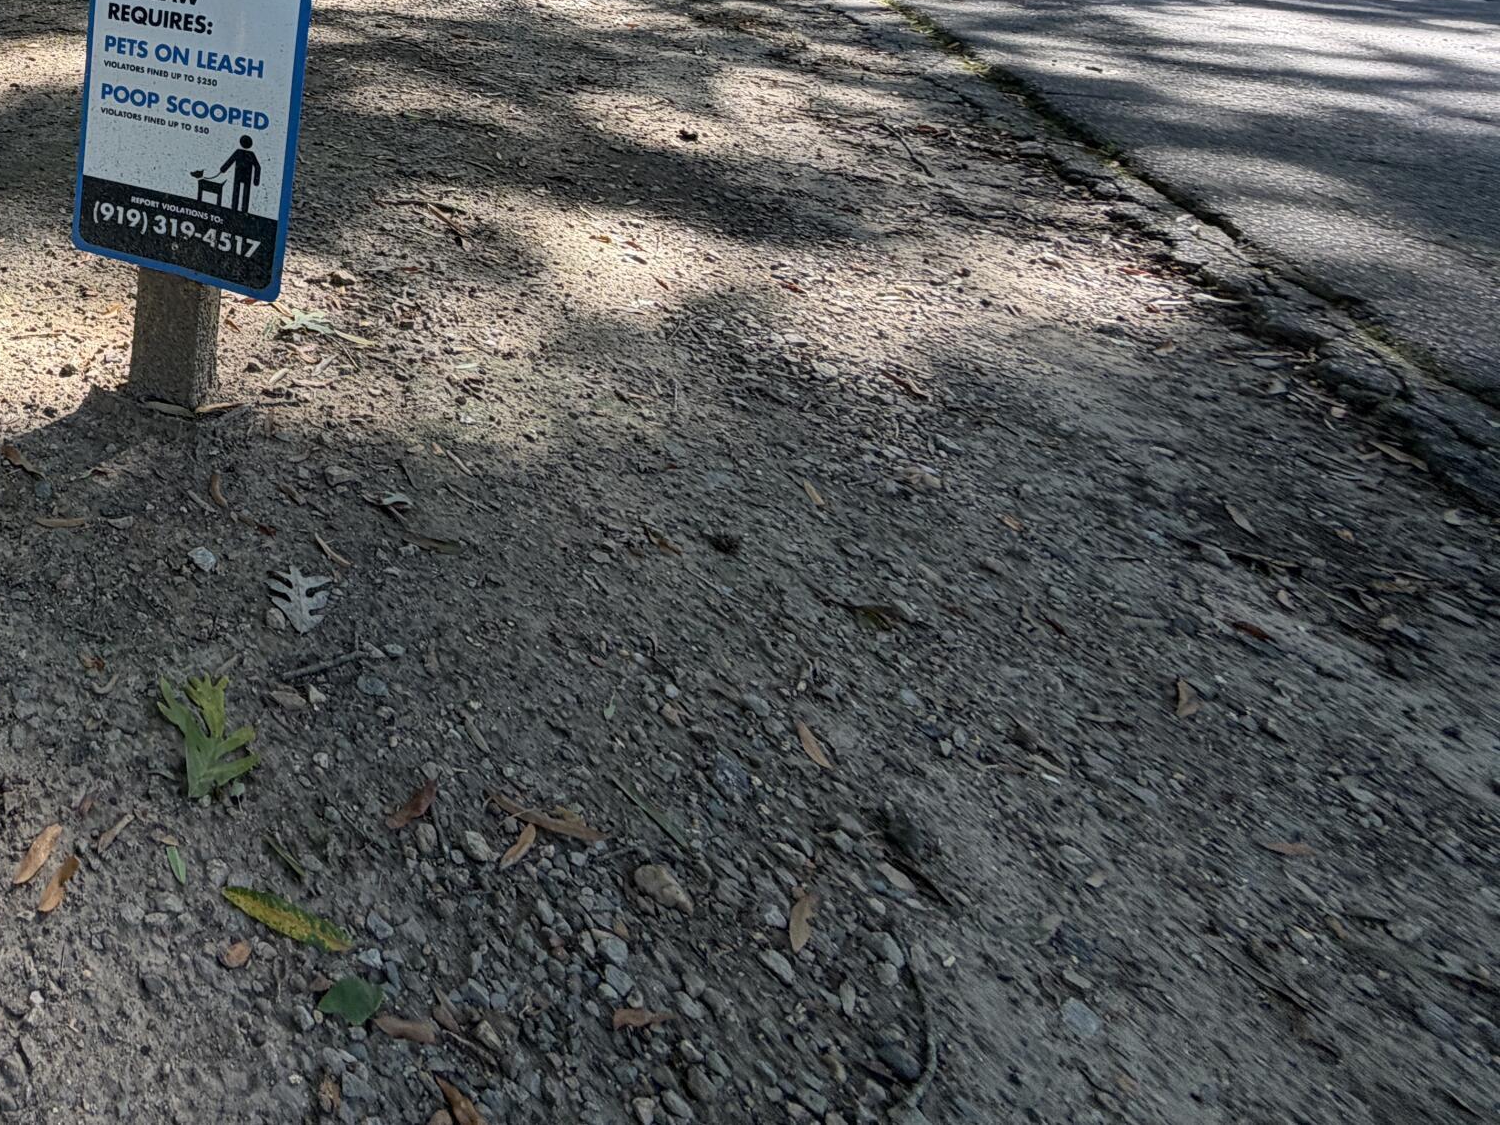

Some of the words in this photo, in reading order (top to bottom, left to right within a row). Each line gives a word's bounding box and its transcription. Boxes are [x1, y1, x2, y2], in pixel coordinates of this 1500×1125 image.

[108, 3, 213, 35] REQUIRES:
[105, 35, 148, 58] PETS
[155, 44, 189, 66] ON
[197, 51, 264, 78] LEASH
[104, 60, 145, 74] VIOLATORS
[147, 68, 168, 77] FINED
[171, 72, 182, 80] UP
[184, 74, 194, 82] TO
[197, 76, 217, 87] $250
[100, 107, 142, 121] VIOLATORS
[144, 115, 166, 126] FINED
[168, 120, 179, 128] UP
[180, 122, 191, 131] TO
[194, 125, 209, 134] $50
[101, 83, 160, 108] POOP
[166, 95, 269, 130] SCOOPED
[131, 196, 160, 209] REPORT
[162, 203, 208, 220] VIOLATIONS
[210, 214, 223, 224] TO:
